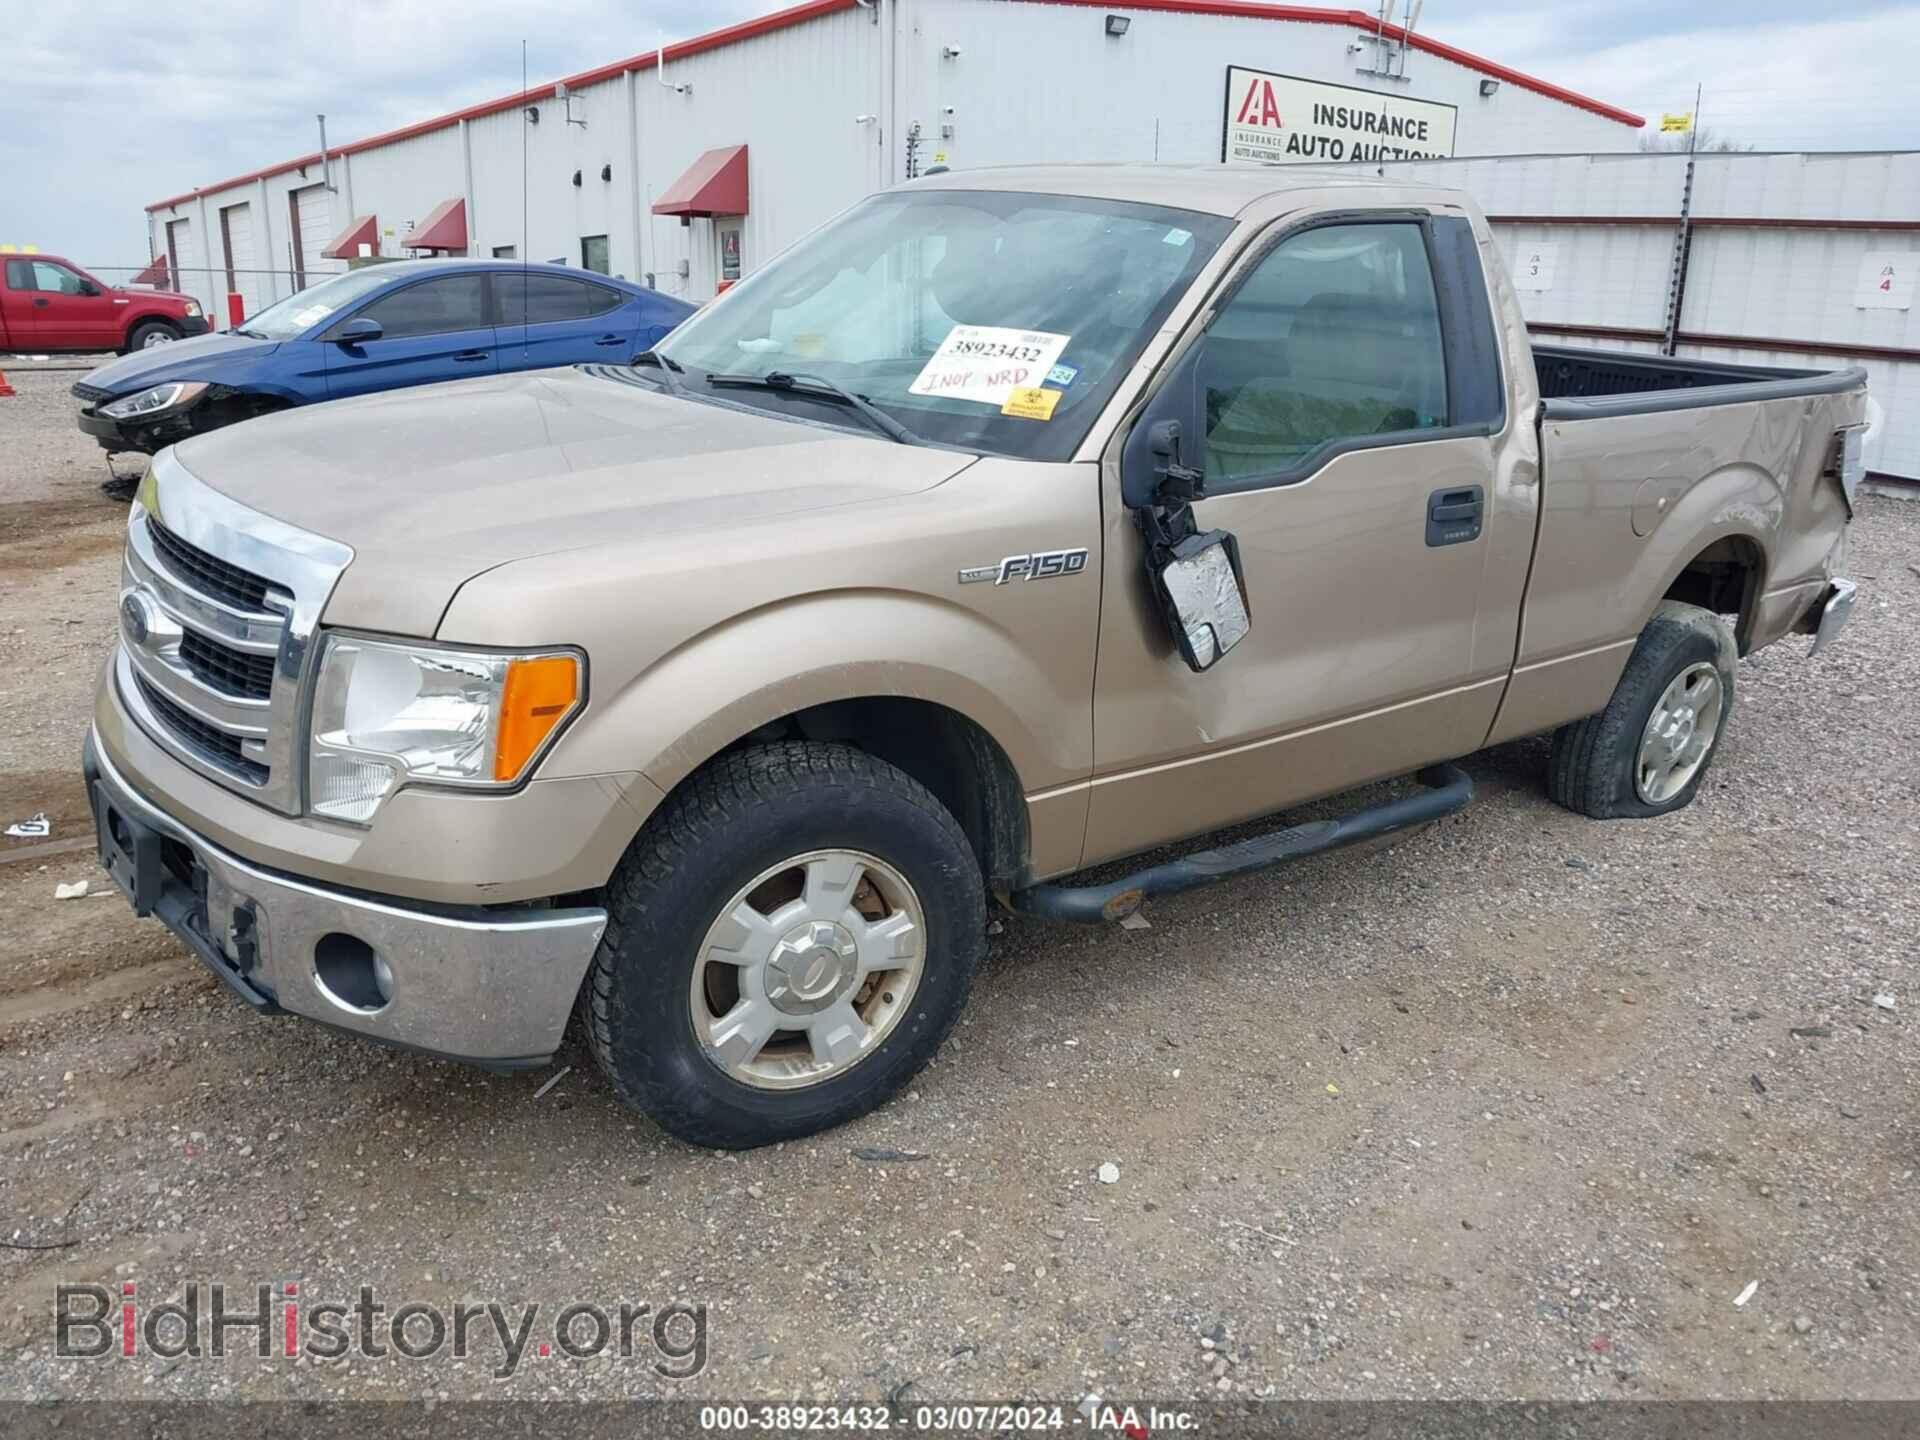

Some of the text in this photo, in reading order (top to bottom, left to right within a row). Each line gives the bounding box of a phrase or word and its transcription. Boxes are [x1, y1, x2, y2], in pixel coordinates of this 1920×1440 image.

[1313, 103, 1428, 141] INSURANCE
[1286, 132, 1344, 160] AUTO
[1530, 265, 1538, 276] 3
[1880, 279, 1890, 292] 4
[950, 340, 1042, 362] 38923432
[996, 549, 1089, 585] F-150
